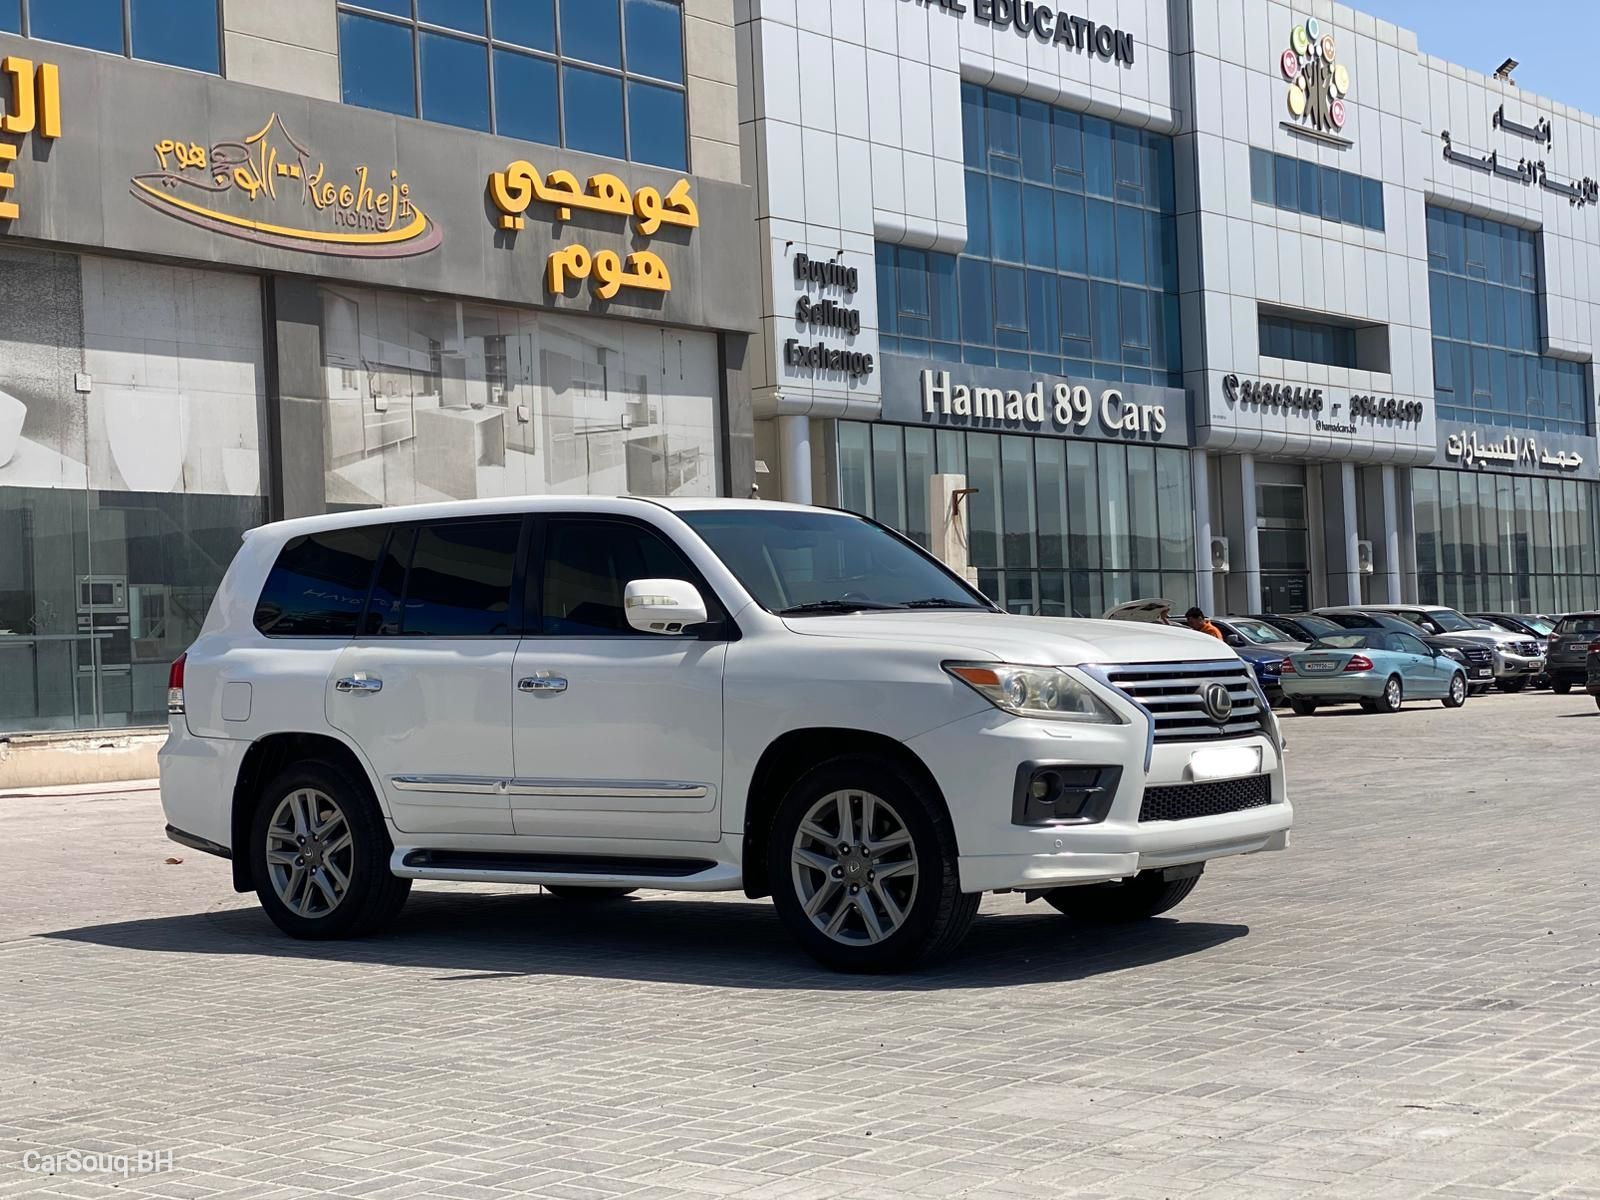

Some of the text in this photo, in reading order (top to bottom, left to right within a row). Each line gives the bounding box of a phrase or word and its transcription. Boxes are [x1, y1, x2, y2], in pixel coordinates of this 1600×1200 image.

[974, 0, 1134, 64] EDUCATION
[0, 56, 61, 138] JI
[491, 160, 699, 235] كوهجي
[334, 206, 388, 231] home
[548, 244, 672, 299] هوم
[794, 253, 858, 294] Buying
[796, 295, 860, 336] Selling
[784, 338, 874, 378] Exchange
[921, 369, 1167, 433] Hamad 89 Cars
[1447, 429, 1518, 467] للسيارات
[1541, 447, 1583, 468] حمد
